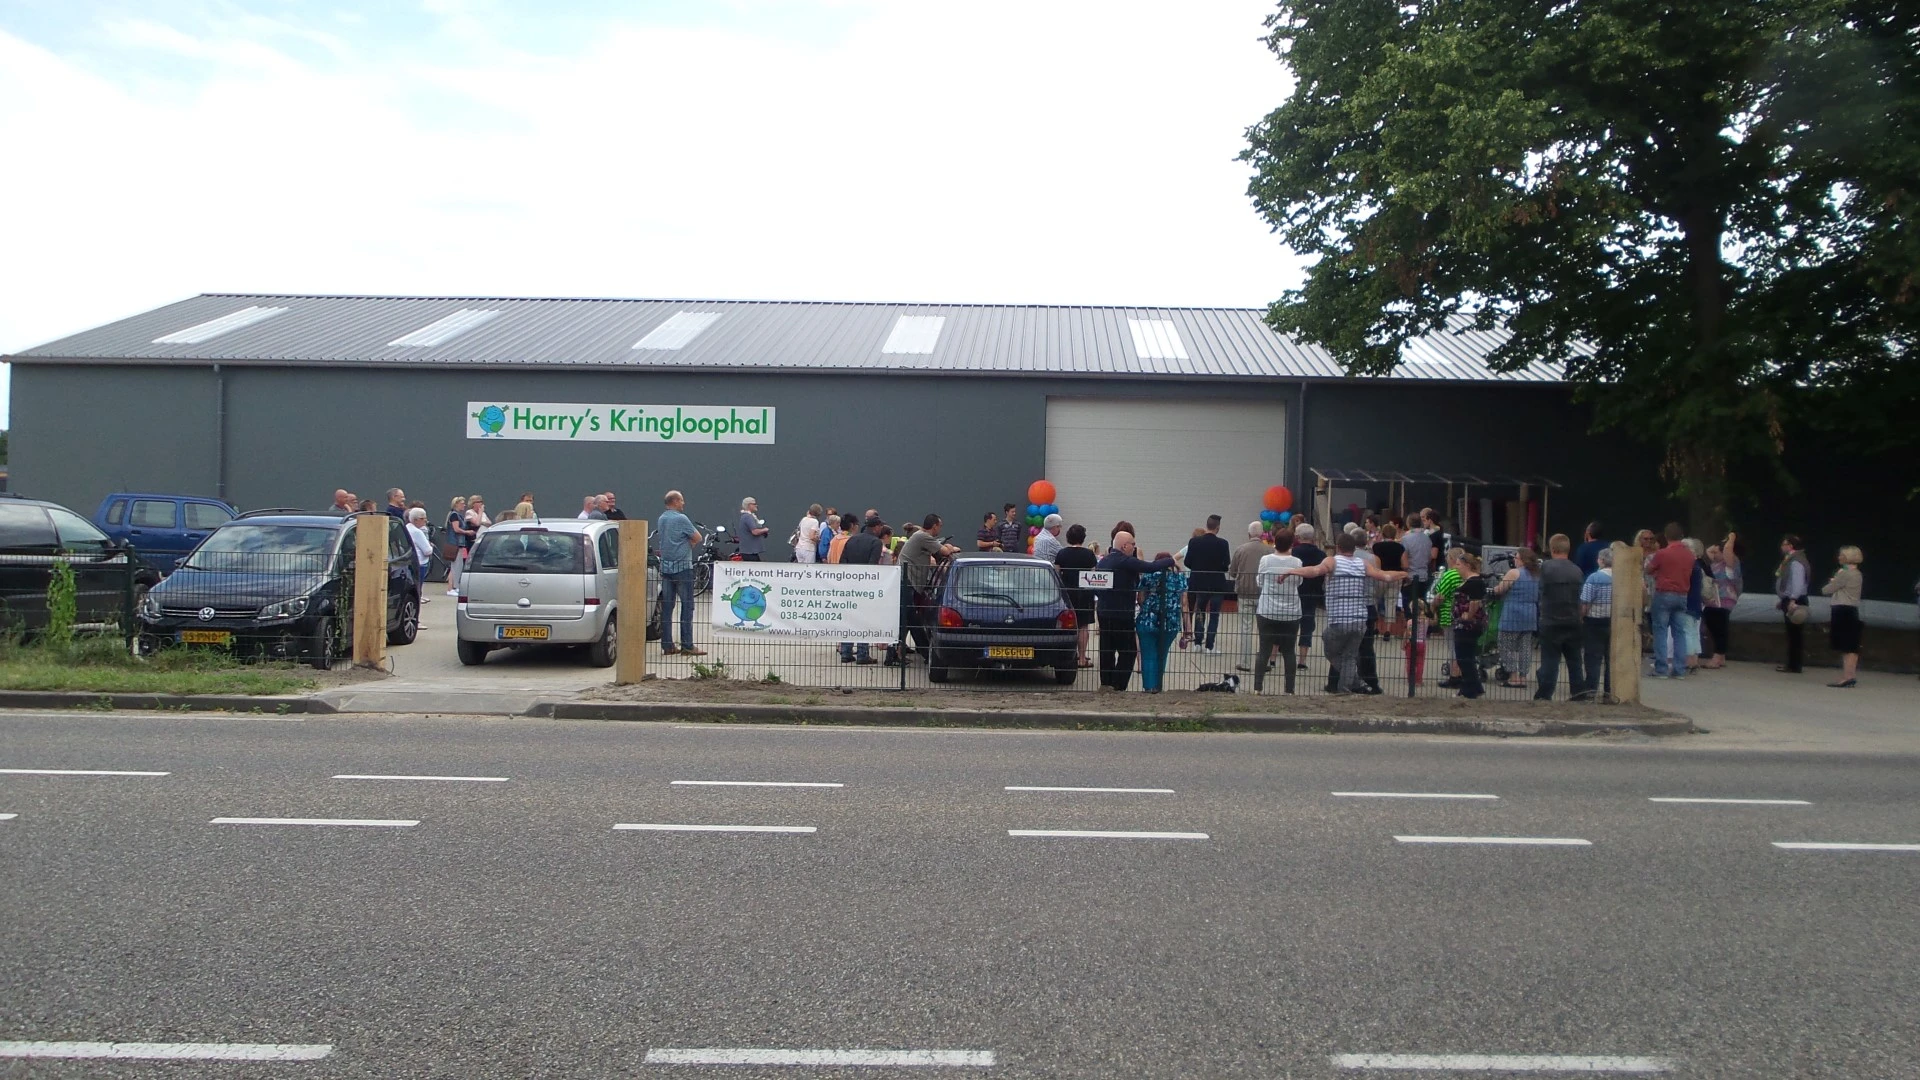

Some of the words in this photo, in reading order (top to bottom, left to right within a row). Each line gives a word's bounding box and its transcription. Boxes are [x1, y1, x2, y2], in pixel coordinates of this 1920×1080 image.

[513, 407, 601, 438] Harry's
[610, 407, 768, 441] Kringloophal
[724, 567, 745, 577] Hier
[749, 568, 774, 578] komt
[776, 569, 812, 582] Harry's
[815, 571, 880, 582] Kringloophal
[1091, 573, 1109, 581] ABC
[781, 587, 875, 599] Deventerstraatweg
[878, 589, 884, 598] 8
[780, 599, 804, 608] 8012
[806, 600, 822, 609] AH
[825, 600, 858, 610] Zwolle
[780, 611, 842, 621] 038-4230024
[505, 628, 545, 637] 70-SN-HG
[768, 627, 893, 639] www.Harryskringloophal.nl
